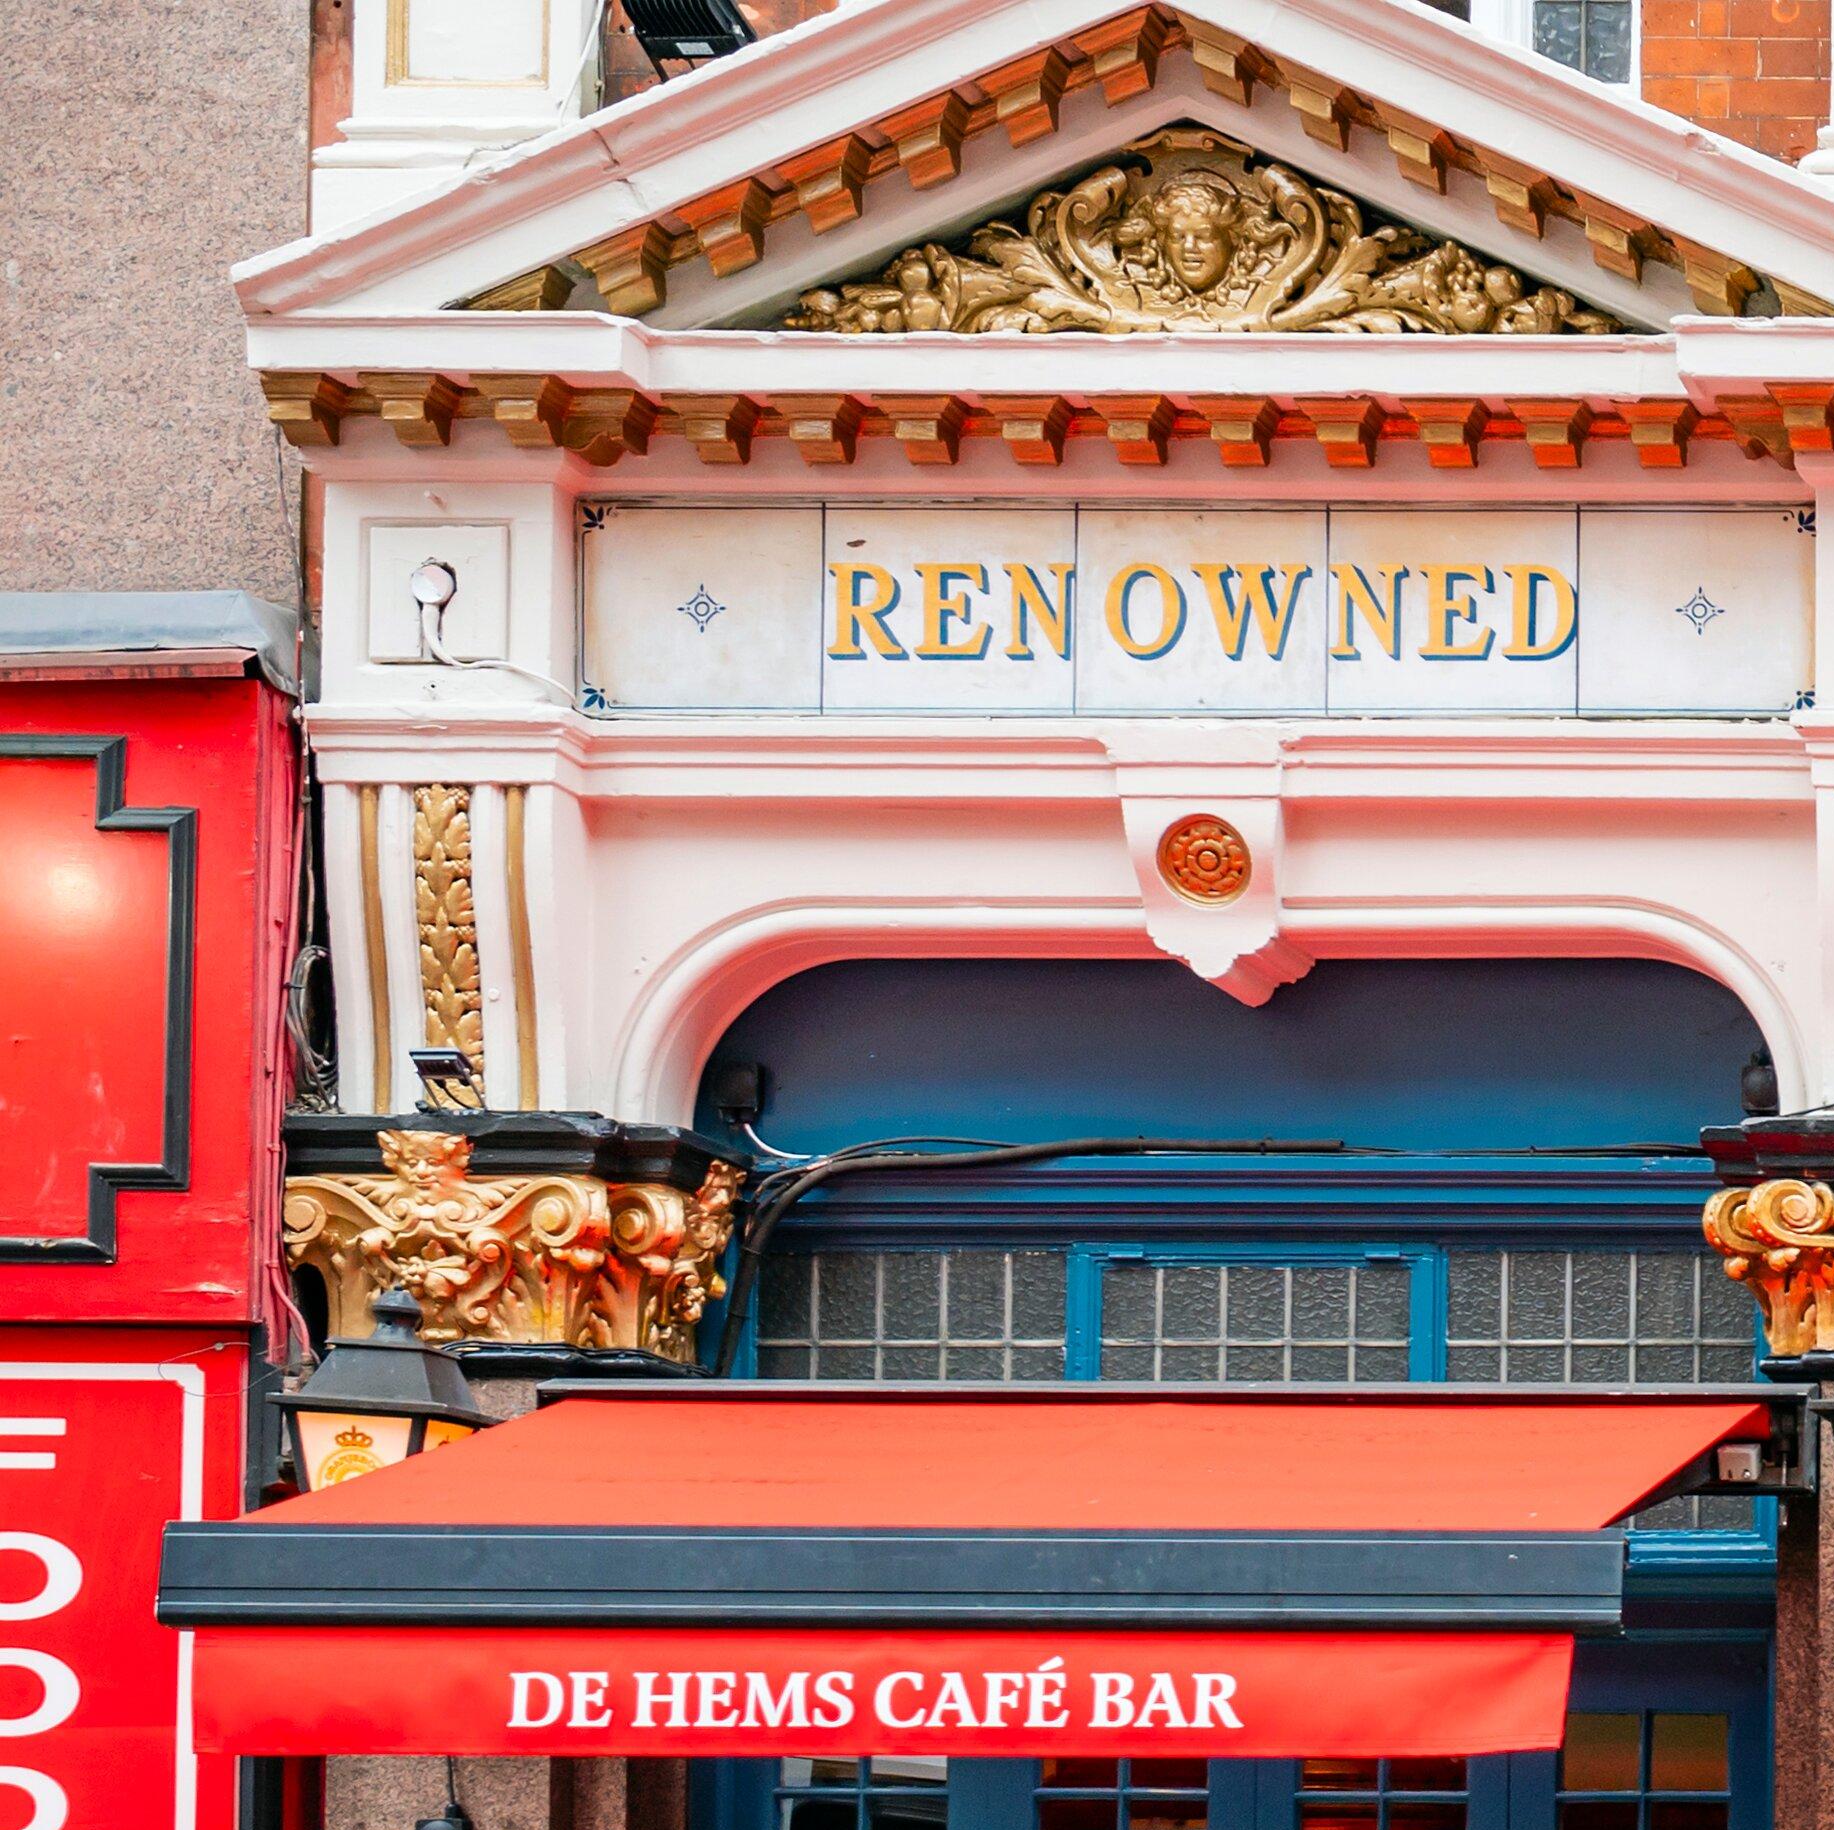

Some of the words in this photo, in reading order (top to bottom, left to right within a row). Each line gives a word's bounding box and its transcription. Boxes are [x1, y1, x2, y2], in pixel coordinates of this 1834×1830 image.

[827, 560, 1579, 662] RENOWNED
[506, 1671, 613, 1728] DE
[631, 1670, 854, 1728] HEMS
[871, 1655, 1070, 1729] CAFÉ
[1087, 1671, 1245, 1729] BAR
